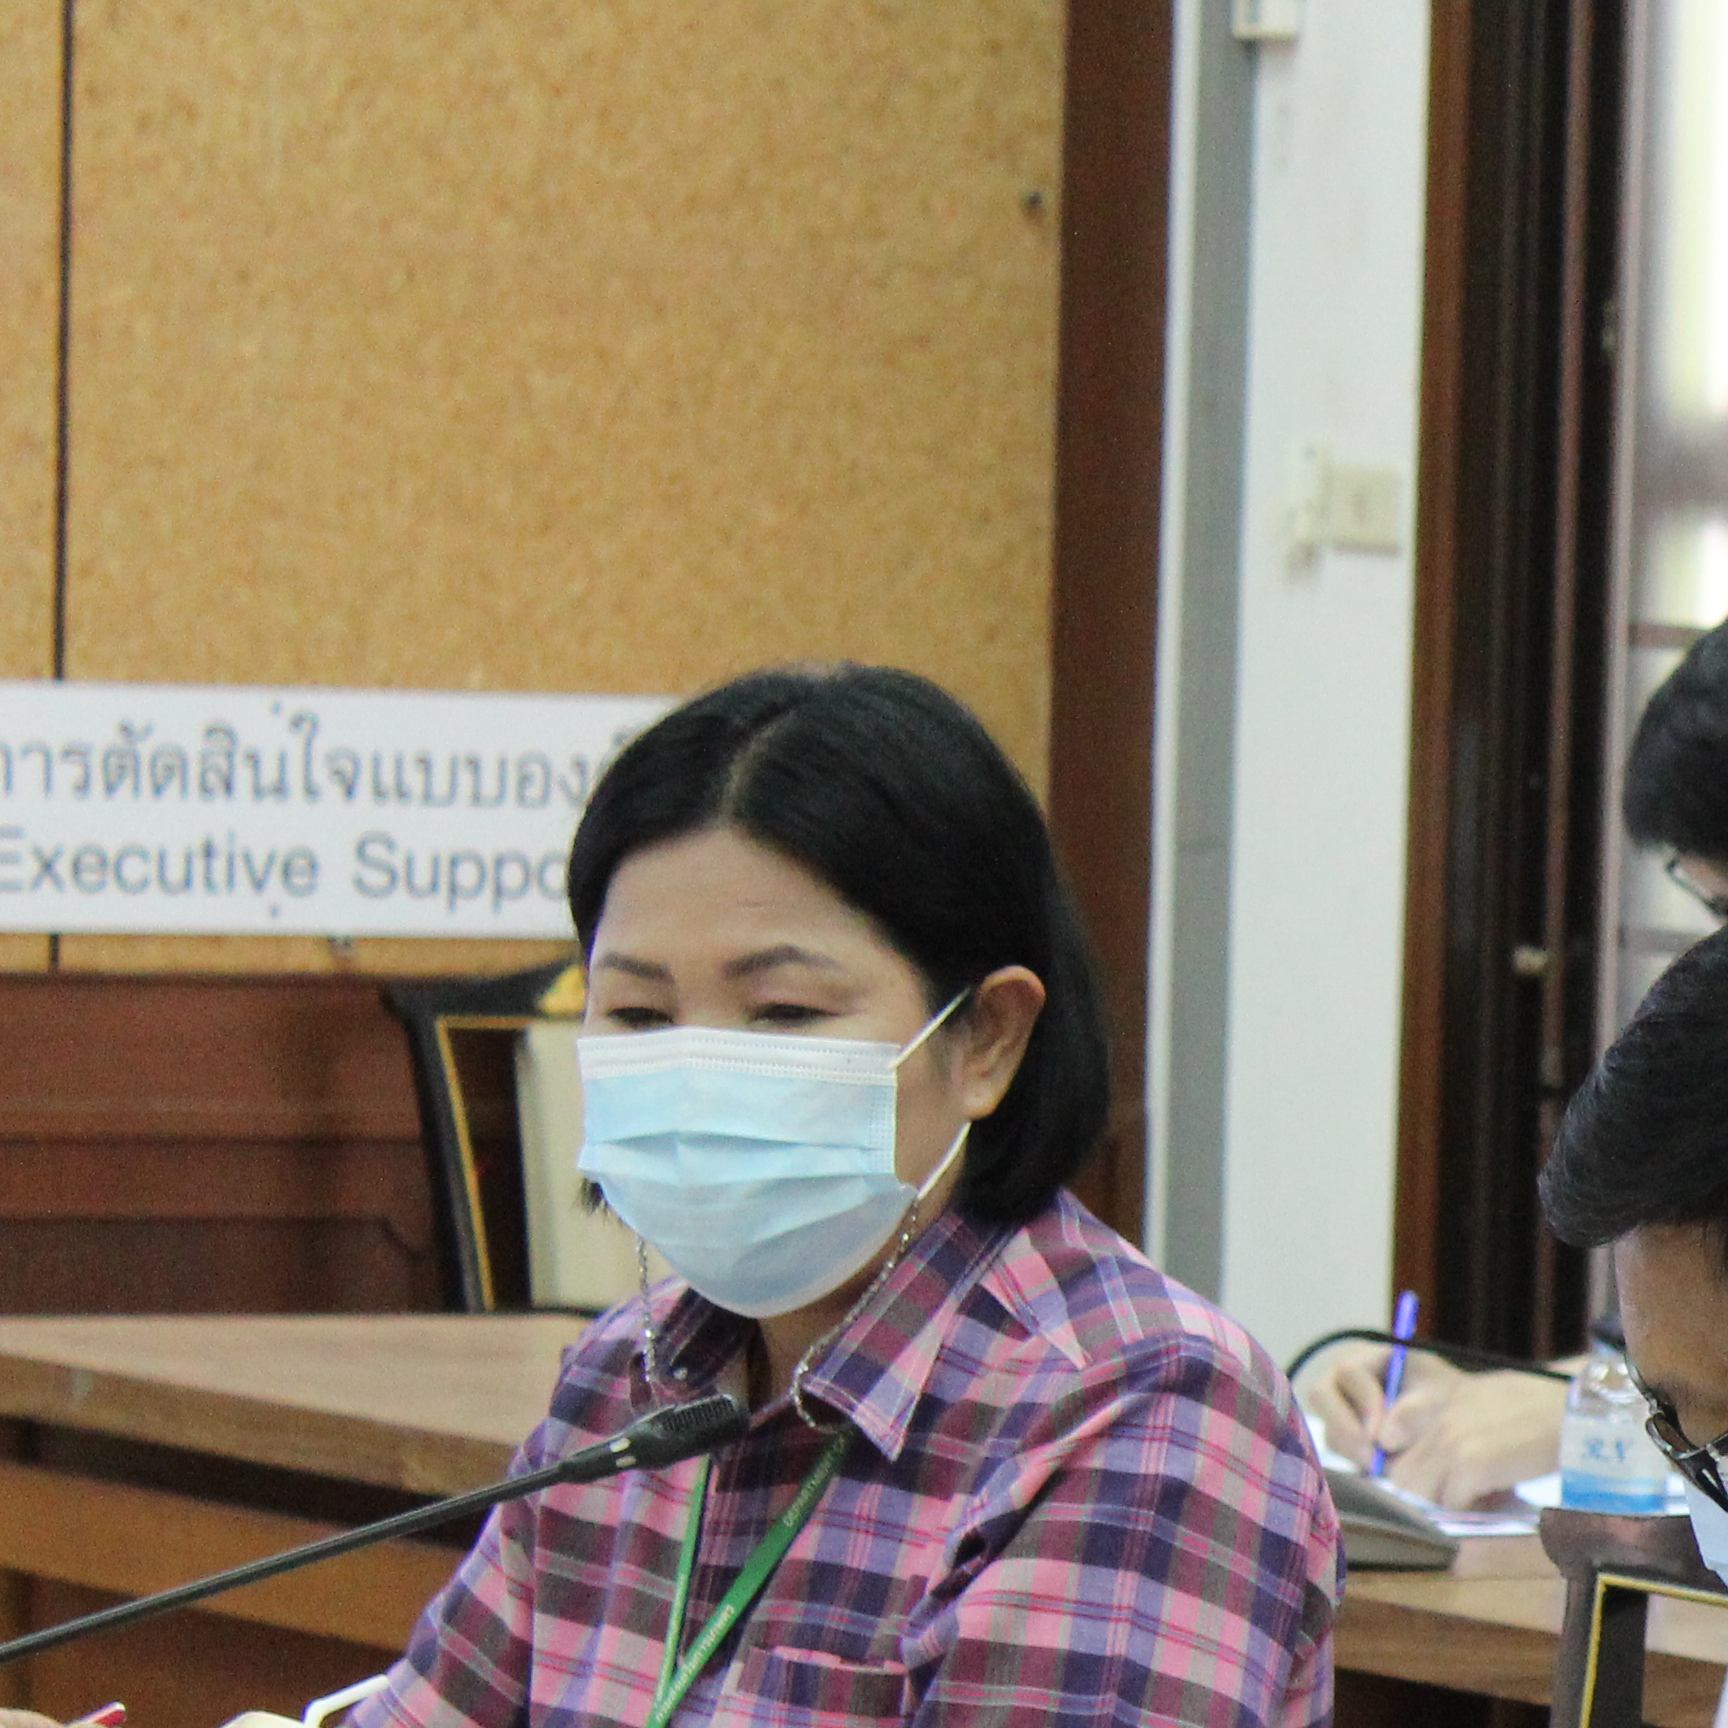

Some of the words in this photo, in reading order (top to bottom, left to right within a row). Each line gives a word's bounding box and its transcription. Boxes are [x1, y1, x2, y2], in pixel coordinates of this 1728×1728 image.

[0, 710, 636, 808] ารตัดสินใจแบบอง
[0, 825, 321, 896] Executive
